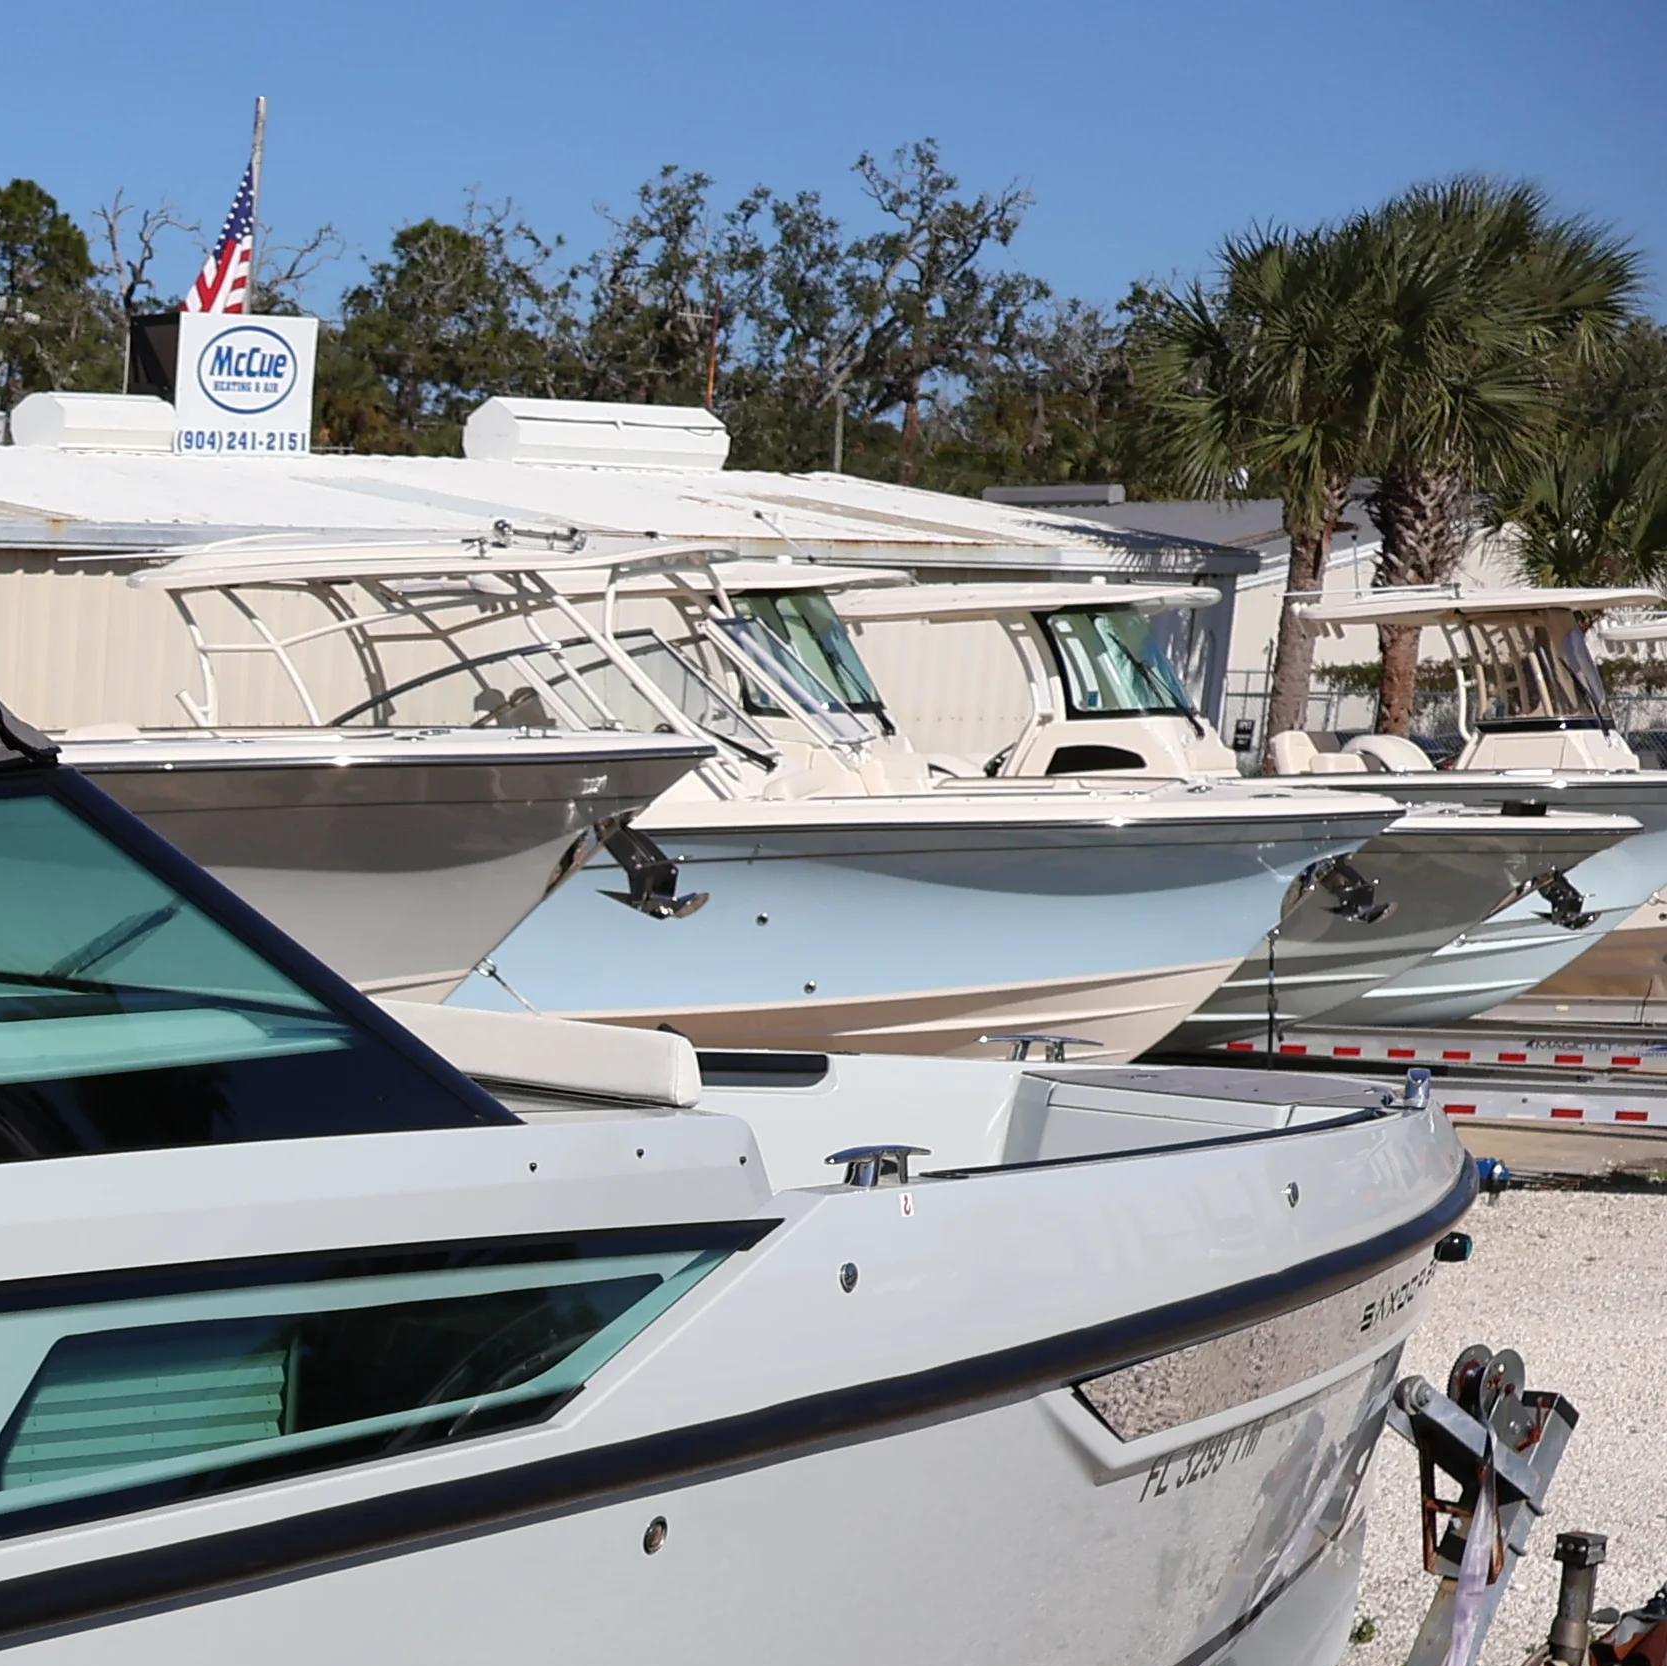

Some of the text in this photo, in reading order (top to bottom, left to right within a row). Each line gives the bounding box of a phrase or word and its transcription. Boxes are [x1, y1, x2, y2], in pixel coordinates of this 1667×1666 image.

[209, 345, 288, 379] McCue
[213, 380, 252, 393] HEATING
[263, 382, 279, 394] AIR
